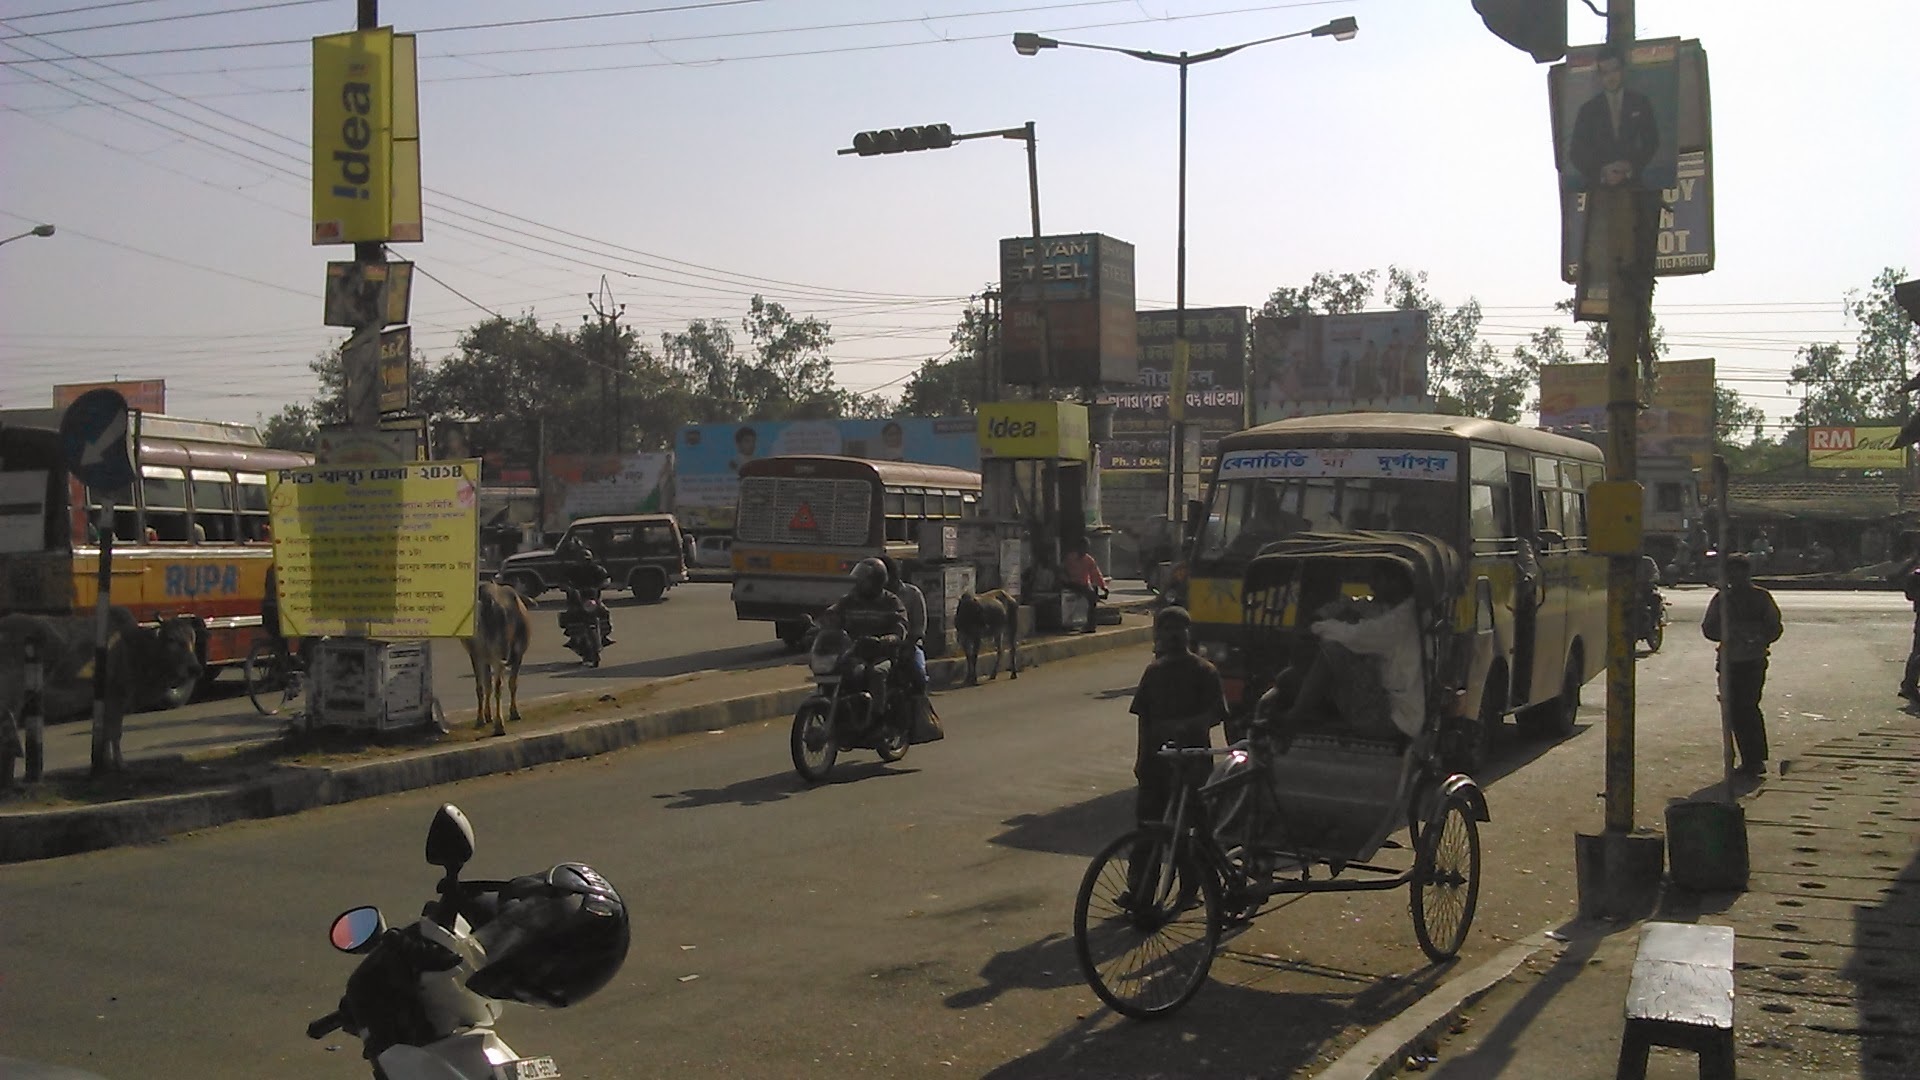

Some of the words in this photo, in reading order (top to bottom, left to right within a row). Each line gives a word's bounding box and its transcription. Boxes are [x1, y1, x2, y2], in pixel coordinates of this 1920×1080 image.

[1813, 430, 1853, 449] RM
[1223, 451, 1309, 471] বেনাচিতি
[1377, 453, 1448, 473] দুর্গাপুর
[279, 469, 313, 485] শিশু
[318, 468, 364, 487] স্বাস্থ্য
[370, 467, 408, 480] মেলা
[164, 564, 238, 597] RUPA
